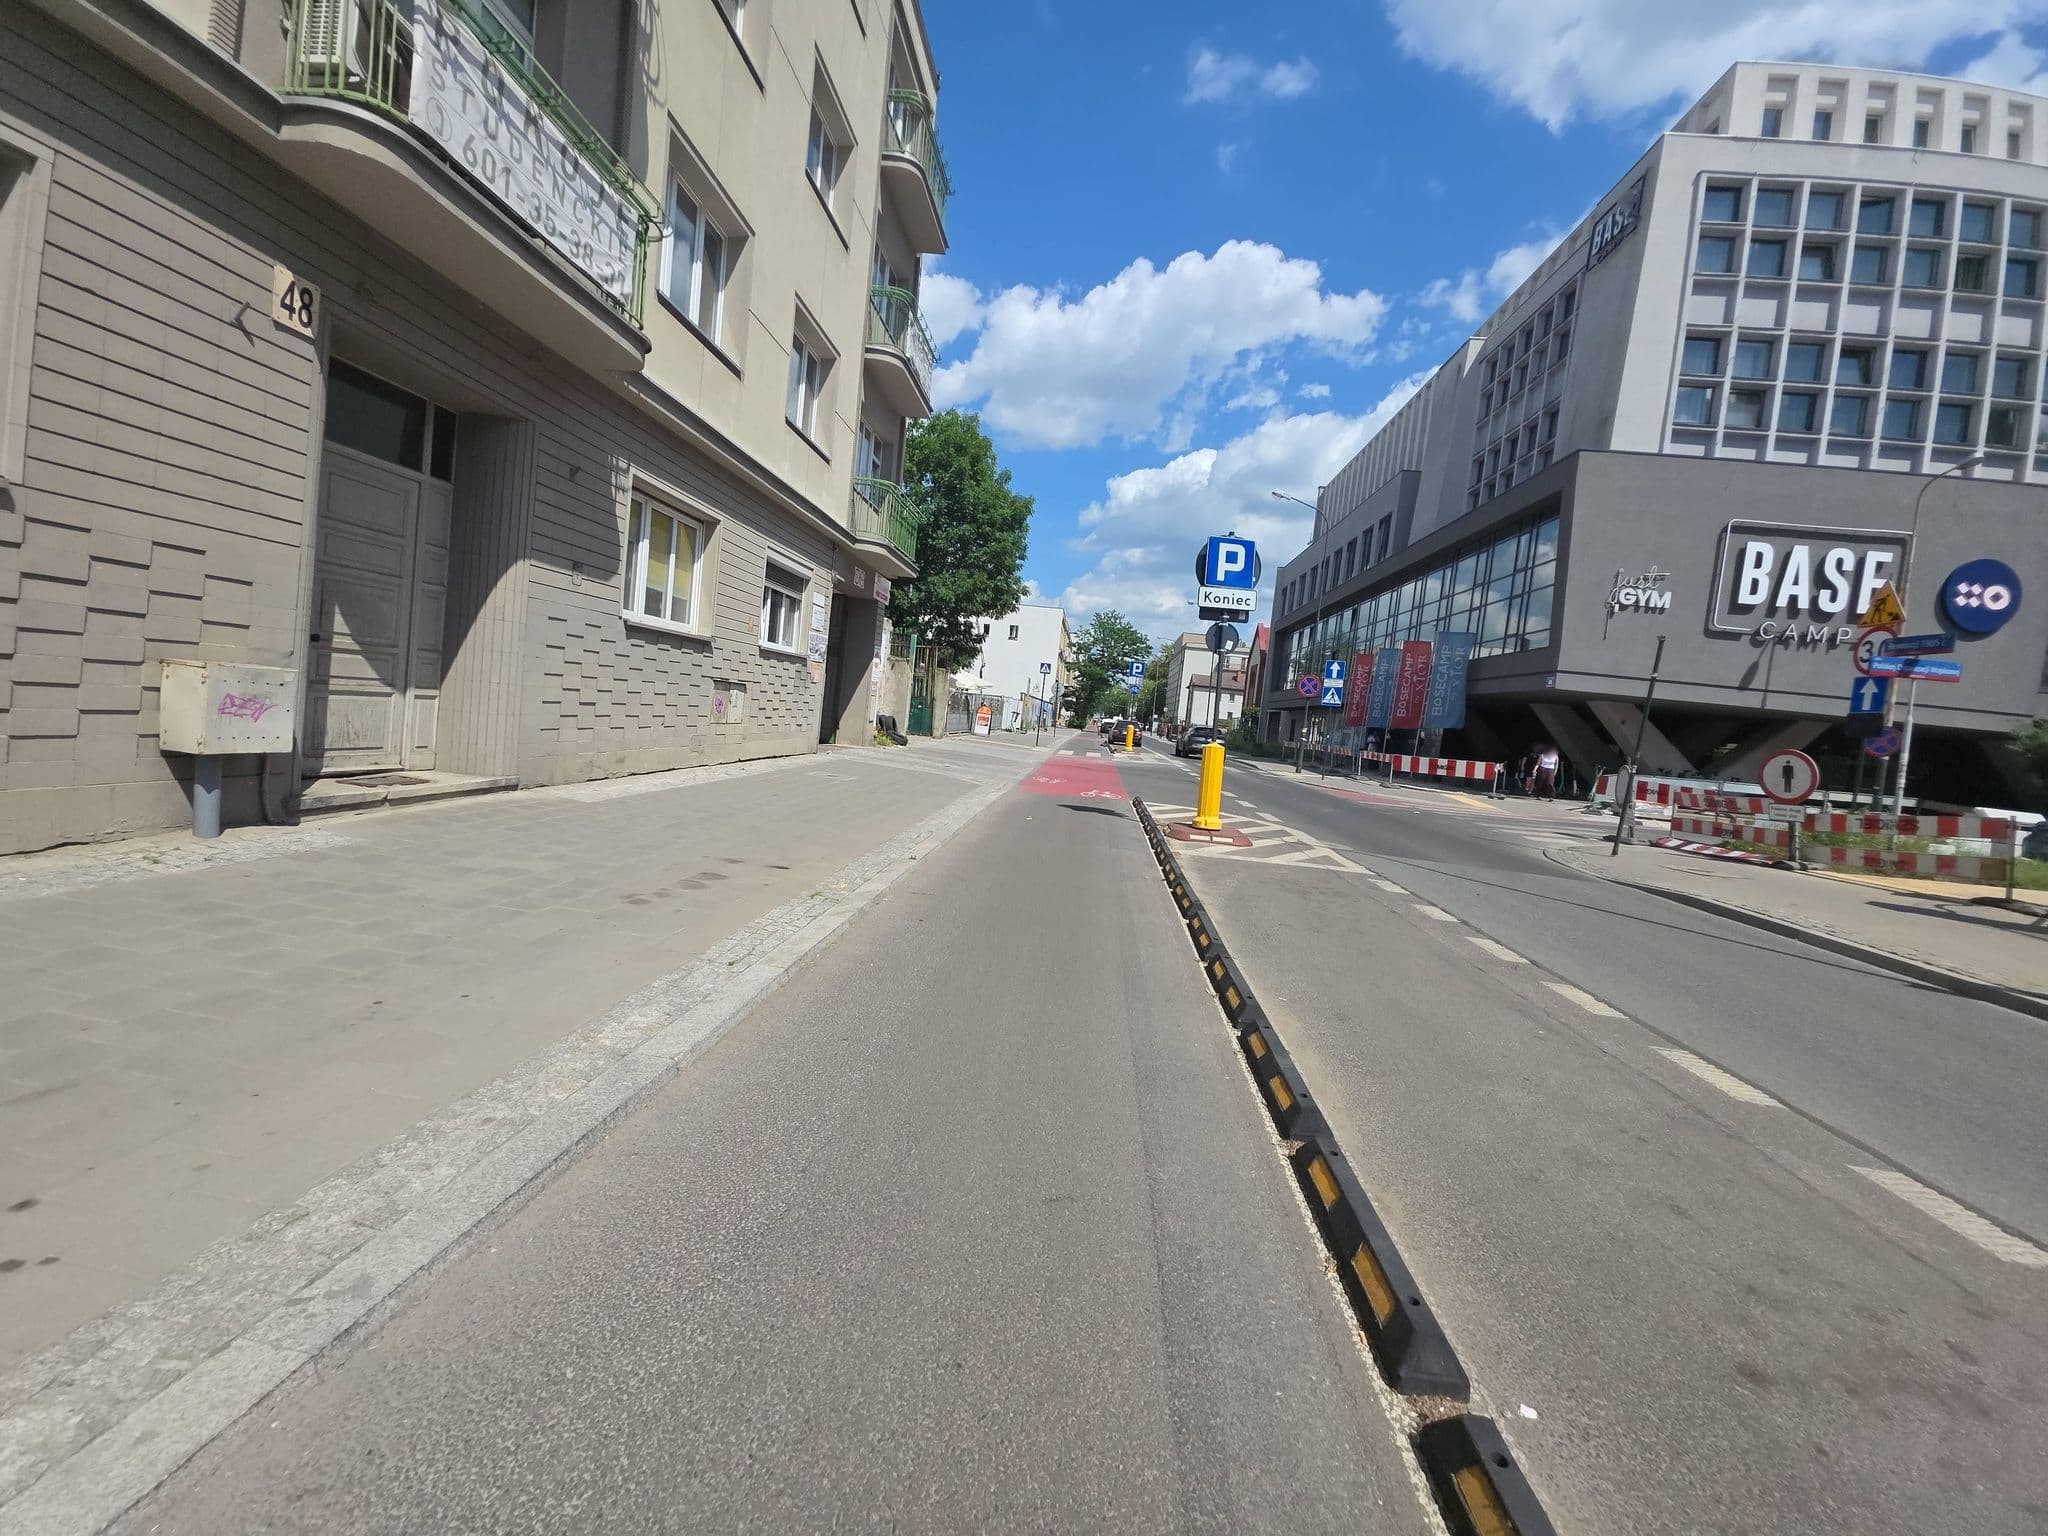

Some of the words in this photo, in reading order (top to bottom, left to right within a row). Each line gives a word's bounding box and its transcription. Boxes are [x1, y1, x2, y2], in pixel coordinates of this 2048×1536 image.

[280, 280, 313, 329] 48
[1216, 542, 1246, 581] P
[1203, 591, 1251, 606] Koniec
[1619, 587, 1672, 609] GYM
[1760, 621, 1852, 645] CAMP
[1132, 662, 1143, 676] P
[1396, 652, 1414, 717] BASECAMP
[1432, 645, 1453, 716] BASECAMP
